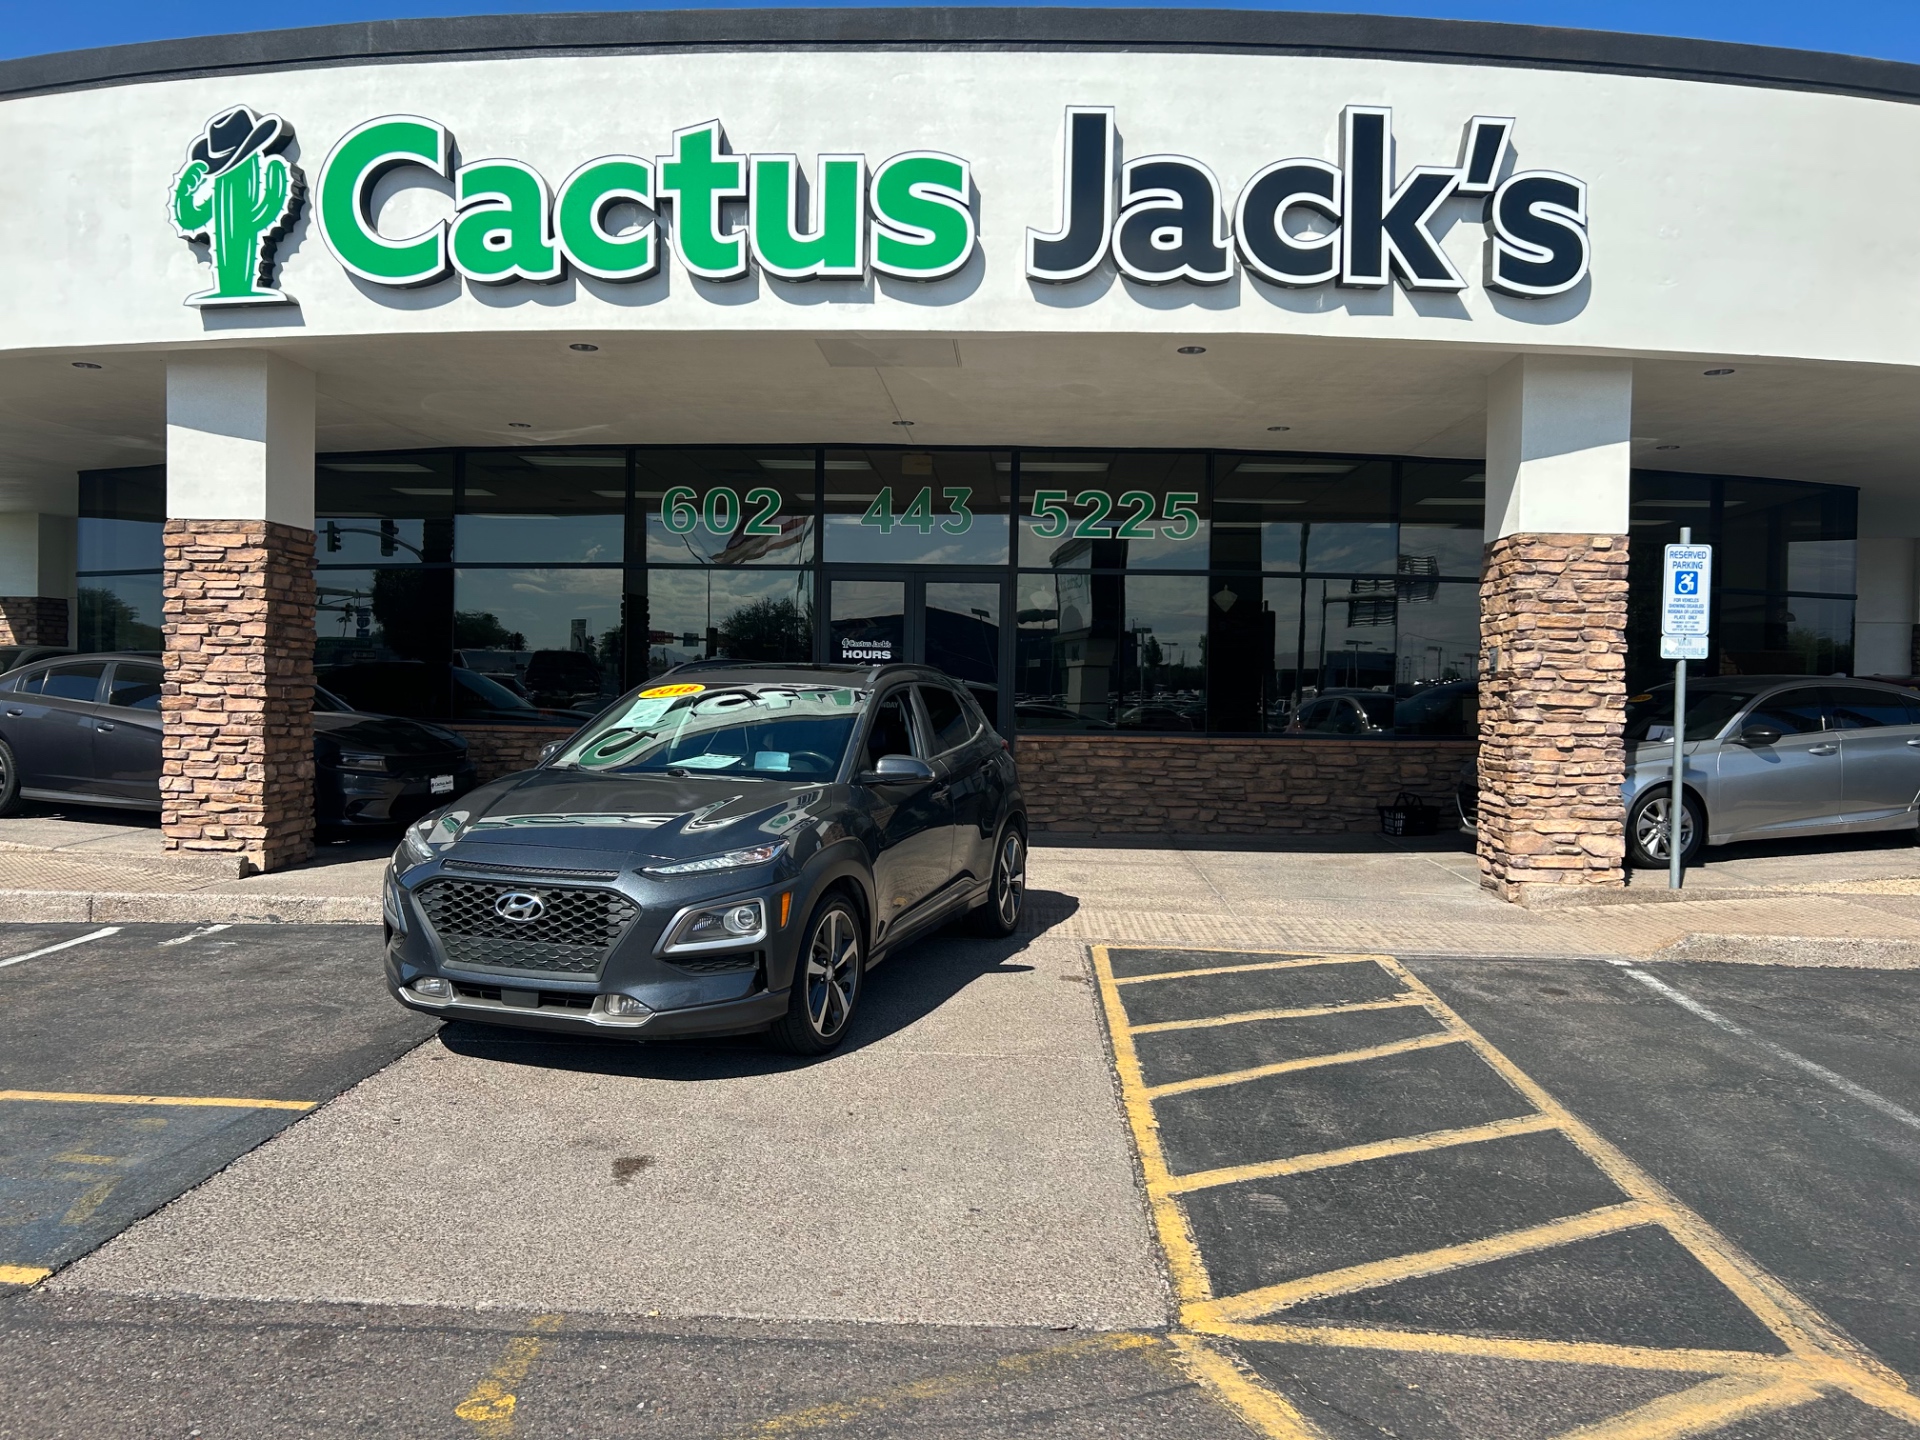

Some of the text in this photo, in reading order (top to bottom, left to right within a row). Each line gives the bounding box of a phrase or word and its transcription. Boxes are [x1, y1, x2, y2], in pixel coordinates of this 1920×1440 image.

[316, 105, 1592, 296] Cactus Jack's
[660, 485, 1200, 540] 602 443 5225
[1669, 551, 1707, 559] RESERVED
[1672, 561, 1703, 569] PARKING
[1677, 638, 1692, 646] VAN
[842, 649, 892, 659] HOURS
[645, 685, 699, 696] 2018
